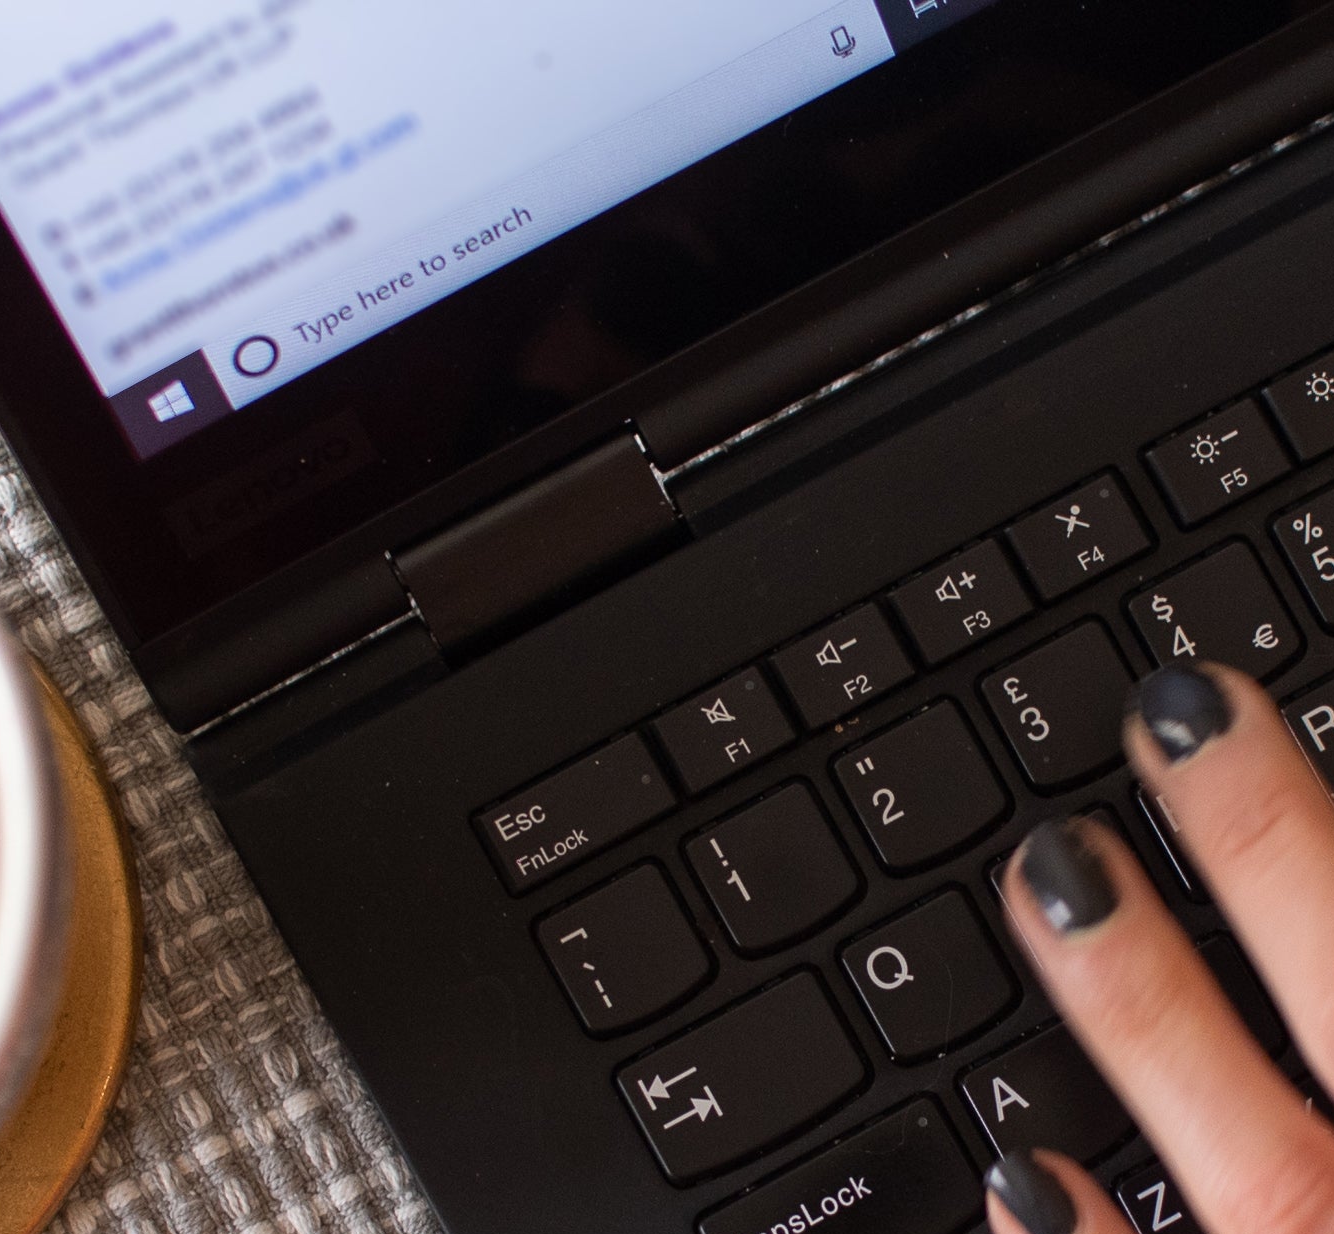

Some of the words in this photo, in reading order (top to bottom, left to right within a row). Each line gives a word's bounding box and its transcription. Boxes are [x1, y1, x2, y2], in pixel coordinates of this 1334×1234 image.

[292, 304, 355, 344] Type
[357, 272, 415, 311] here
[419, 253, 447, 277] to
[452, 207, 533, 261] search
[1220, 468, 1249, 494] F5
[1077, 545, 1106, 571] F4
[963, 610, 992, 636] F3
[1172, 625, 1196, 658] 4
[843, 675, 872, 700] F2
[1020, 706, 1050, 742] 3
[724, 738, 751, 763] F1
[494, 804, 547, 841] Esc
[872, 788, 904, 825] 2
[516, 828, 588, 876] FnLock
[727, 870, 751, 901] 1
[866, 945, 914, 989] Q
[991, 1076, 1030, 1123] A
[1136, 1181, 1182, 1232] Z
